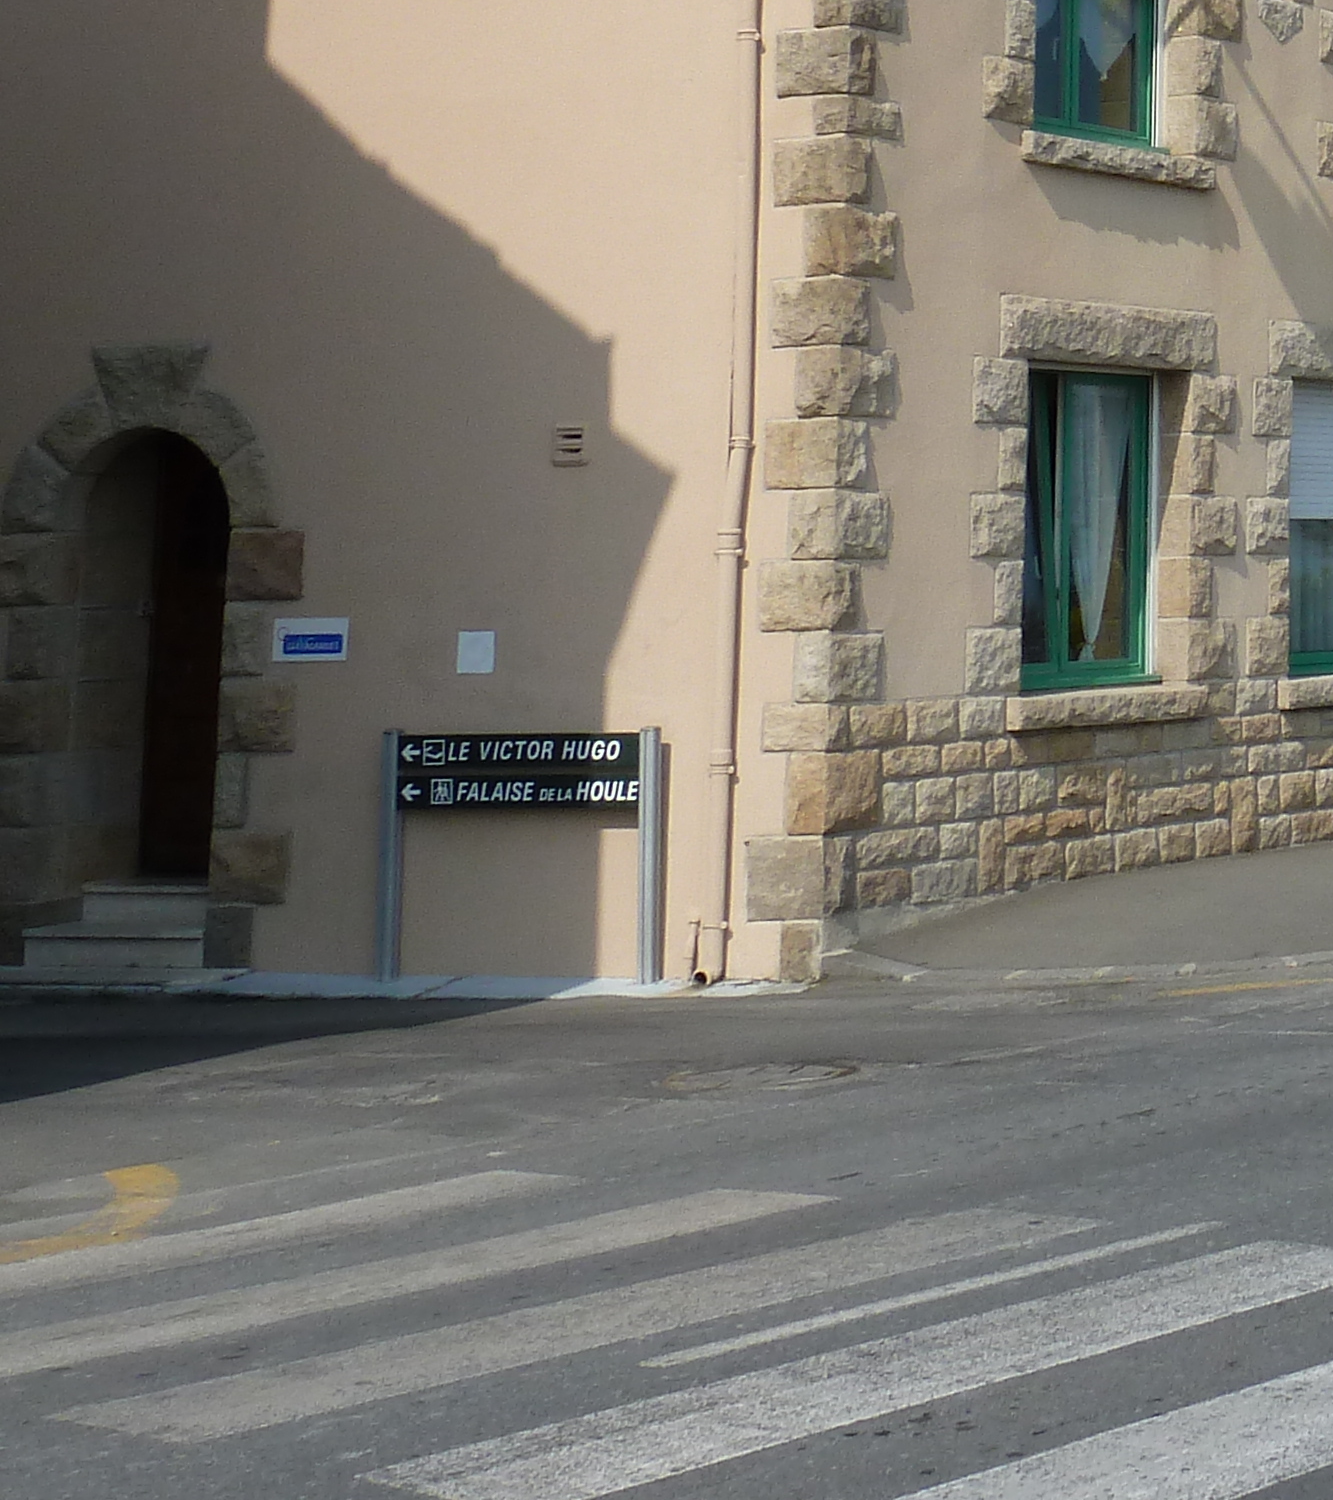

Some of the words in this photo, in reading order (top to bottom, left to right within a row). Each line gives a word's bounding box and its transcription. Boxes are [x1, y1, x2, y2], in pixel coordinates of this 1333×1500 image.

[447, 741, 471, 761] LE
[479, 740, 555, 761] VICTOR
[561, 739, 621, 760] HUGO
[456, 781, 535, 802] FALAISE
[576, 780, 640, 801] HOULE
